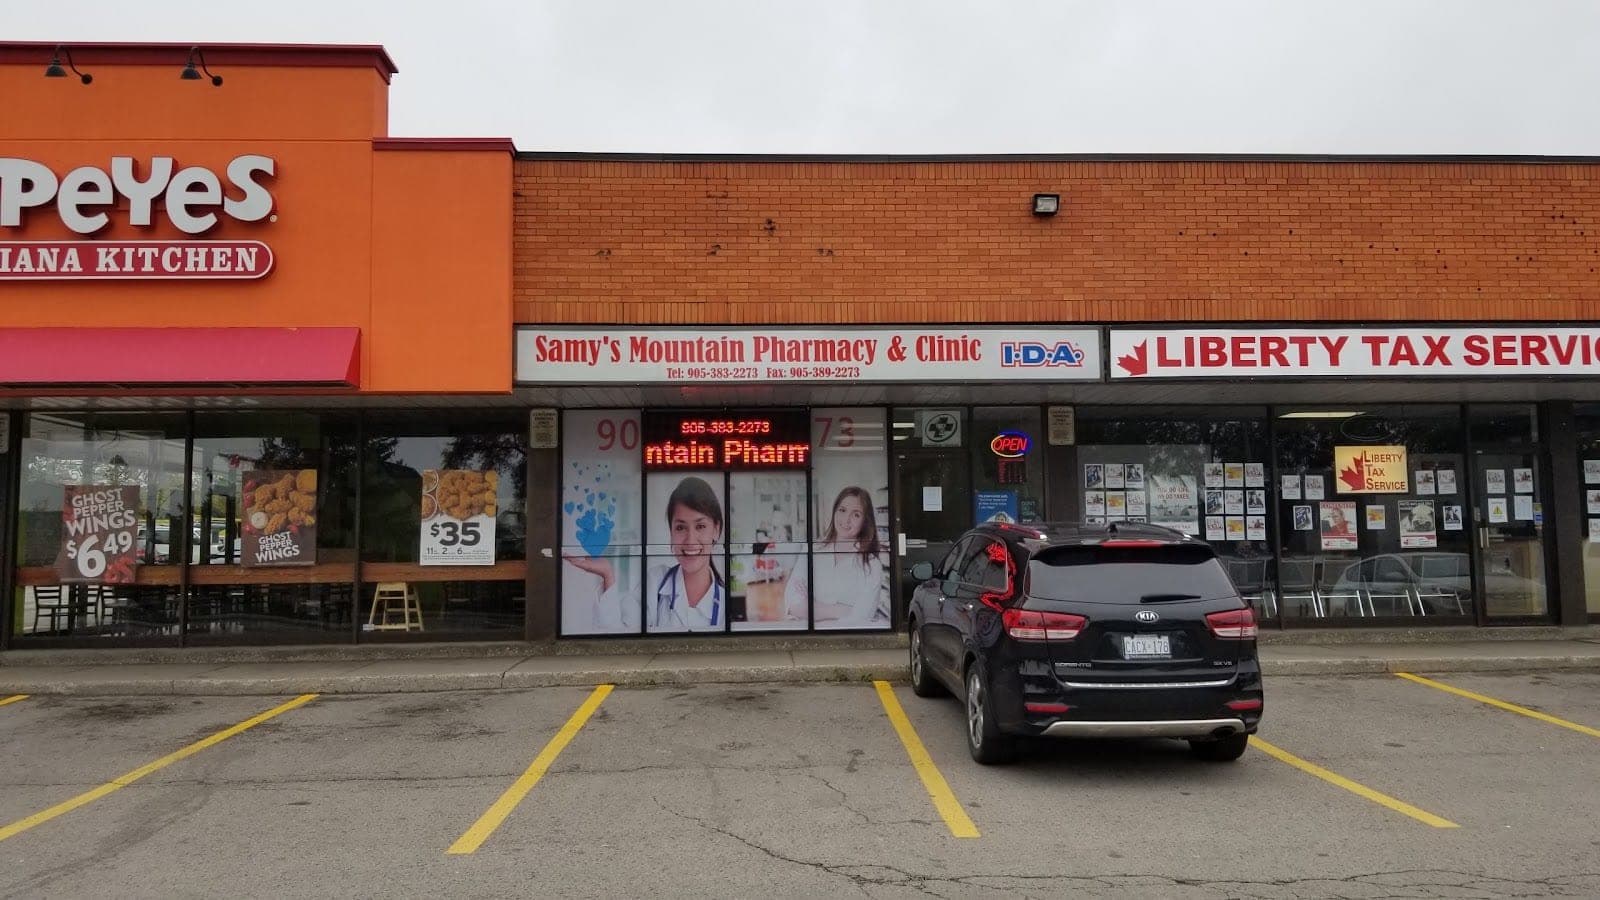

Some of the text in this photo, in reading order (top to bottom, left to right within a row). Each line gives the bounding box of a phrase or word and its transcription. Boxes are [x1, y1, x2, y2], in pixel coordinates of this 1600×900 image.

[96, 247, 258, 272] KITCHEN
[535, 335, 981, 366] Samy's Mountain Pharmacy & Clinic
[1156, 334, 1600, 368] LIBERTY TAX SERVI
[666, 367, 860, 379] Tel: 905-383-2273 Fax: 905-389-2273
[597, 419, 640, 451] 90
[681, 421, 770, 434] 905-383-2273
[645, 440, 715, 464] ntain
[993, 437, 1028, 451] OPEN
[72, 488, 123, 507] GHOST
[73, 500, 125, 519] PEPPER
[65, 509, 136, 537] WINGS
[258, 531, 291, 545] GHOST
[430, 521, 481, 546] $35
[255, 544, 300, 563] WINGS
[259, 539, 293, 552] PEPPER
[1137, 611, 1158, 622] KIA
